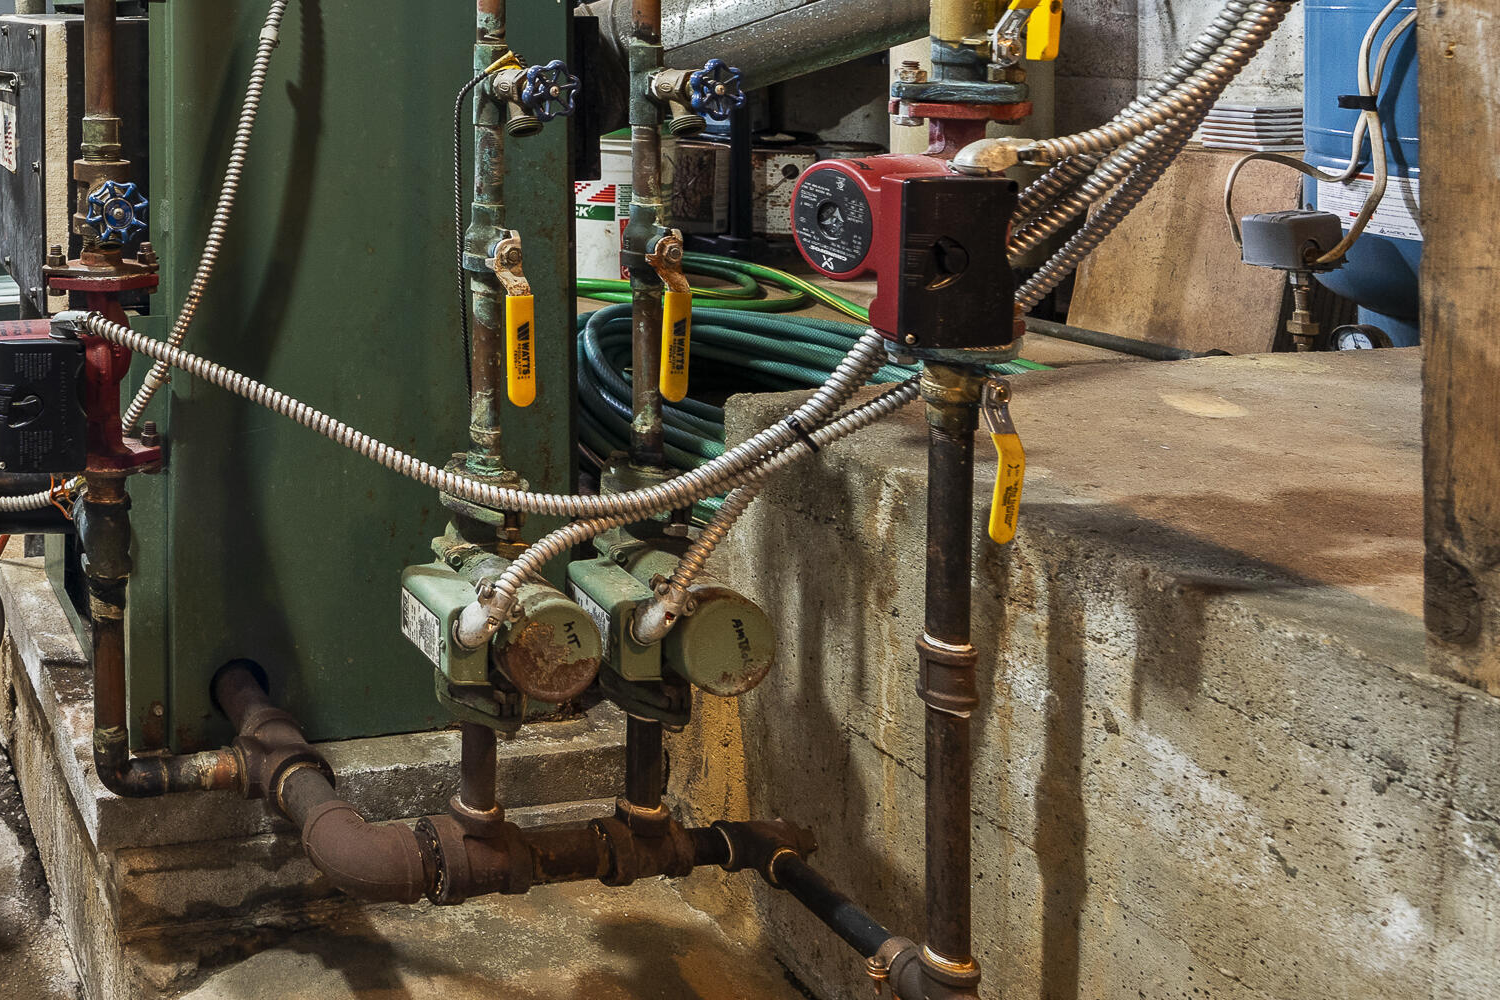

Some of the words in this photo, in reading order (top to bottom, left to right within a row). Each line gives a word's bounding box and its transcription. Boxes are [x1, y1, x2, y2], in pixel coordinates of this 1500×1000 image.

[522, 342, 531, 375] WATTS
[676, 338, 685, 370] WATTS
[563, 620, 582, 649] KIT
